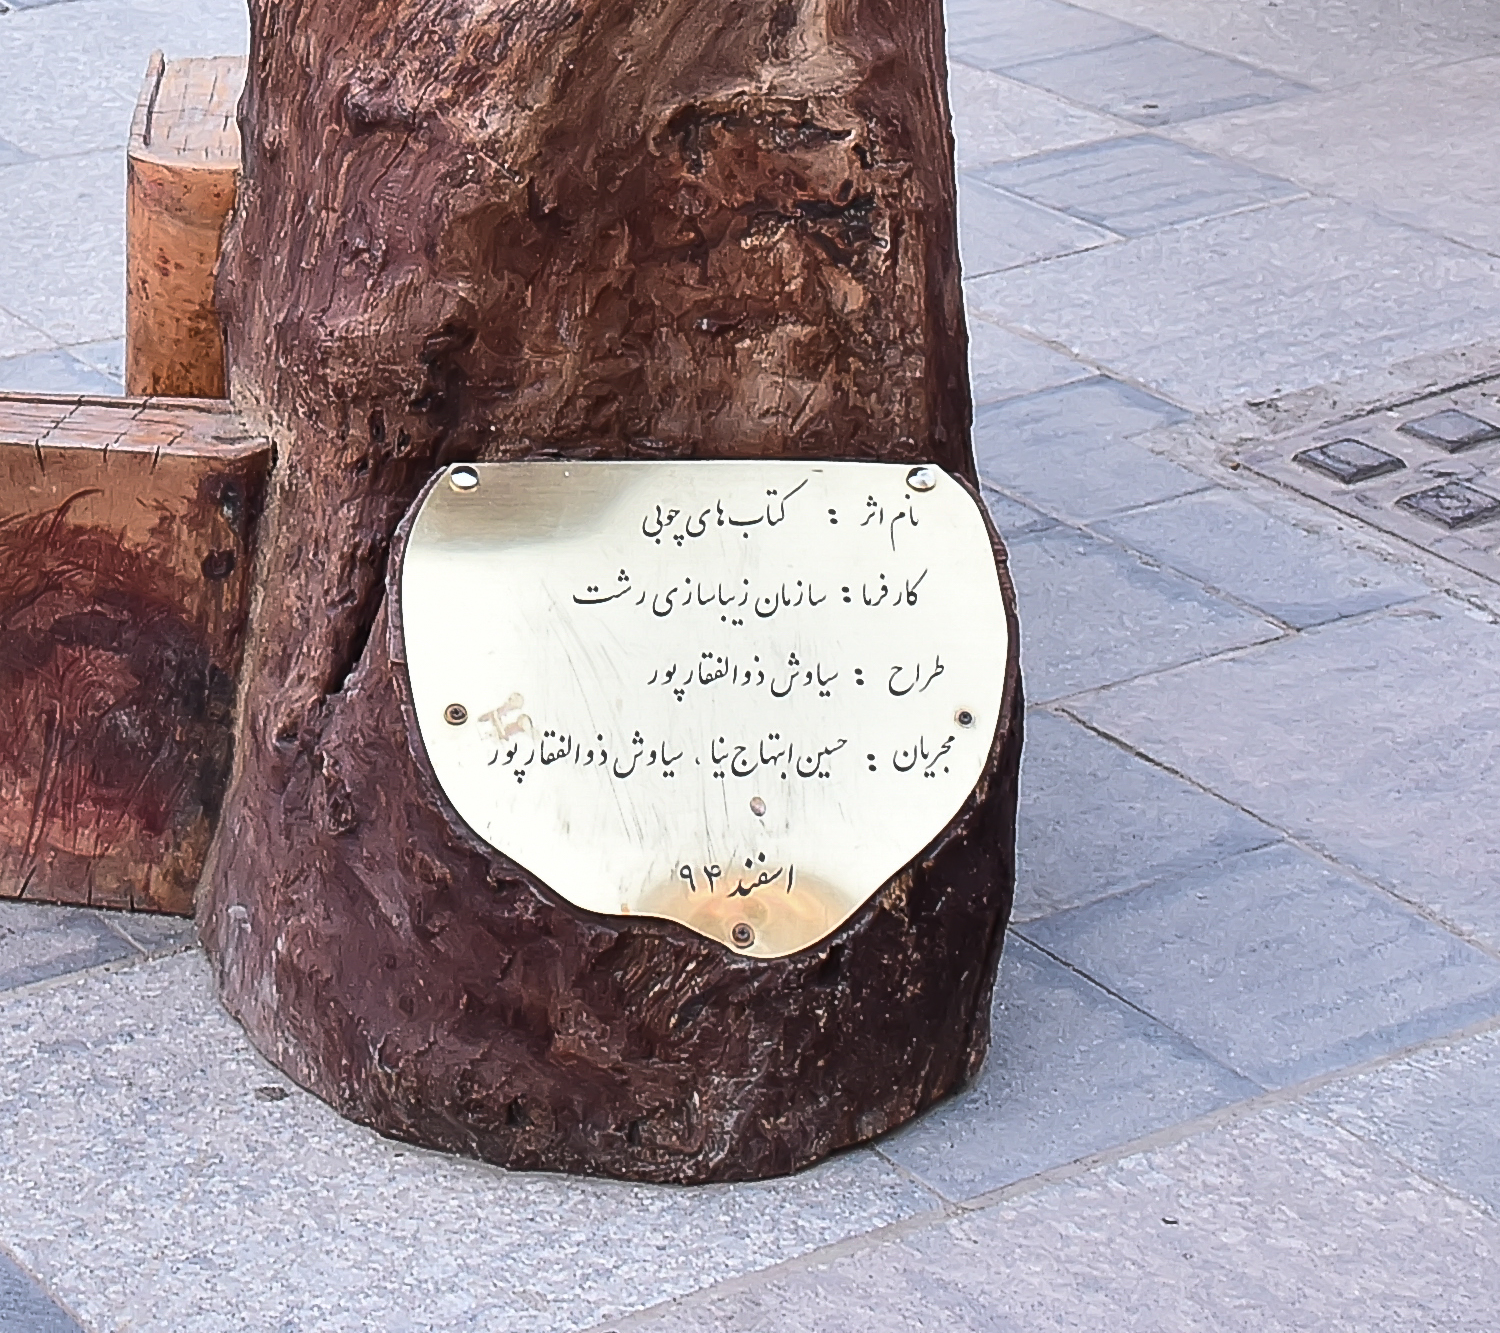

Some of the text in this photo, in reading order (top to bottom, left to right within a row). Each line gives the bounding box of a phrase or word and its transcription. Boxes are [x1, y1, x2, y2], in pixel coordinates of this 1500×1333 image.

[641, 504, 685, 547] چوبی
[860, 495, 885, 527] اثر
[890, 493, 919, 552] نام
[572, 569, 647, 606] رشت
[754, 580, 827, 618] سازمان
[861, 569, 928, 607] کارفرما
[770, 652, 838, 698] سیاوش
[888, 655, 945, 697] طراح
[612, 730, 683, 779] سیاوش
[796, 737, 848, 779] حسین
[892, 735, 957, 778] مجریان
[679, 851, 794, 899] اسفند ۹۴
